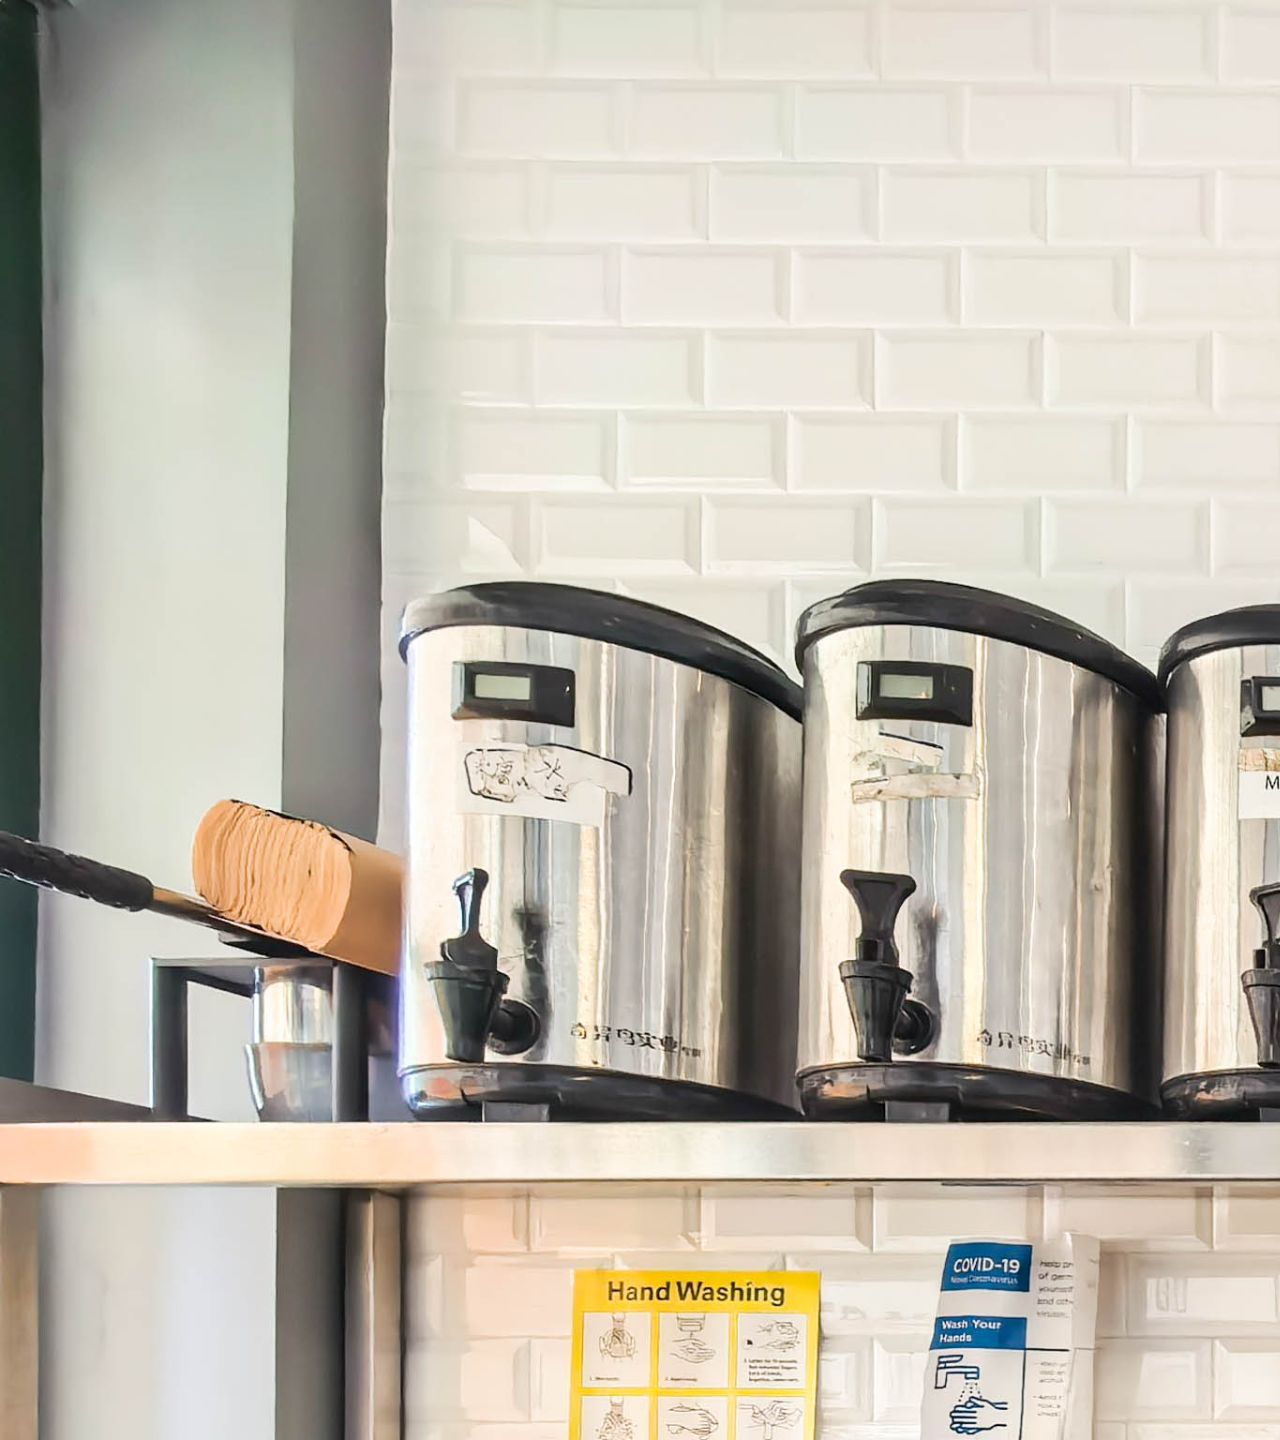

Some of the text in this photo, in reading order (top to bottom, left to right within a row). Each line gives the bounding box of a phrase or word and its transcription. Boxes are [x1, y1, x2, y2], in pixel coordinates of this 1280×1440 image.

[953, 1257, 1020, 1273] COVID-19
[608, 1281, 786, 1306] Hand Washing
[942, 1319, 1002, 1330] Wash Your
[940, 1333, 973, 1343] Hands
